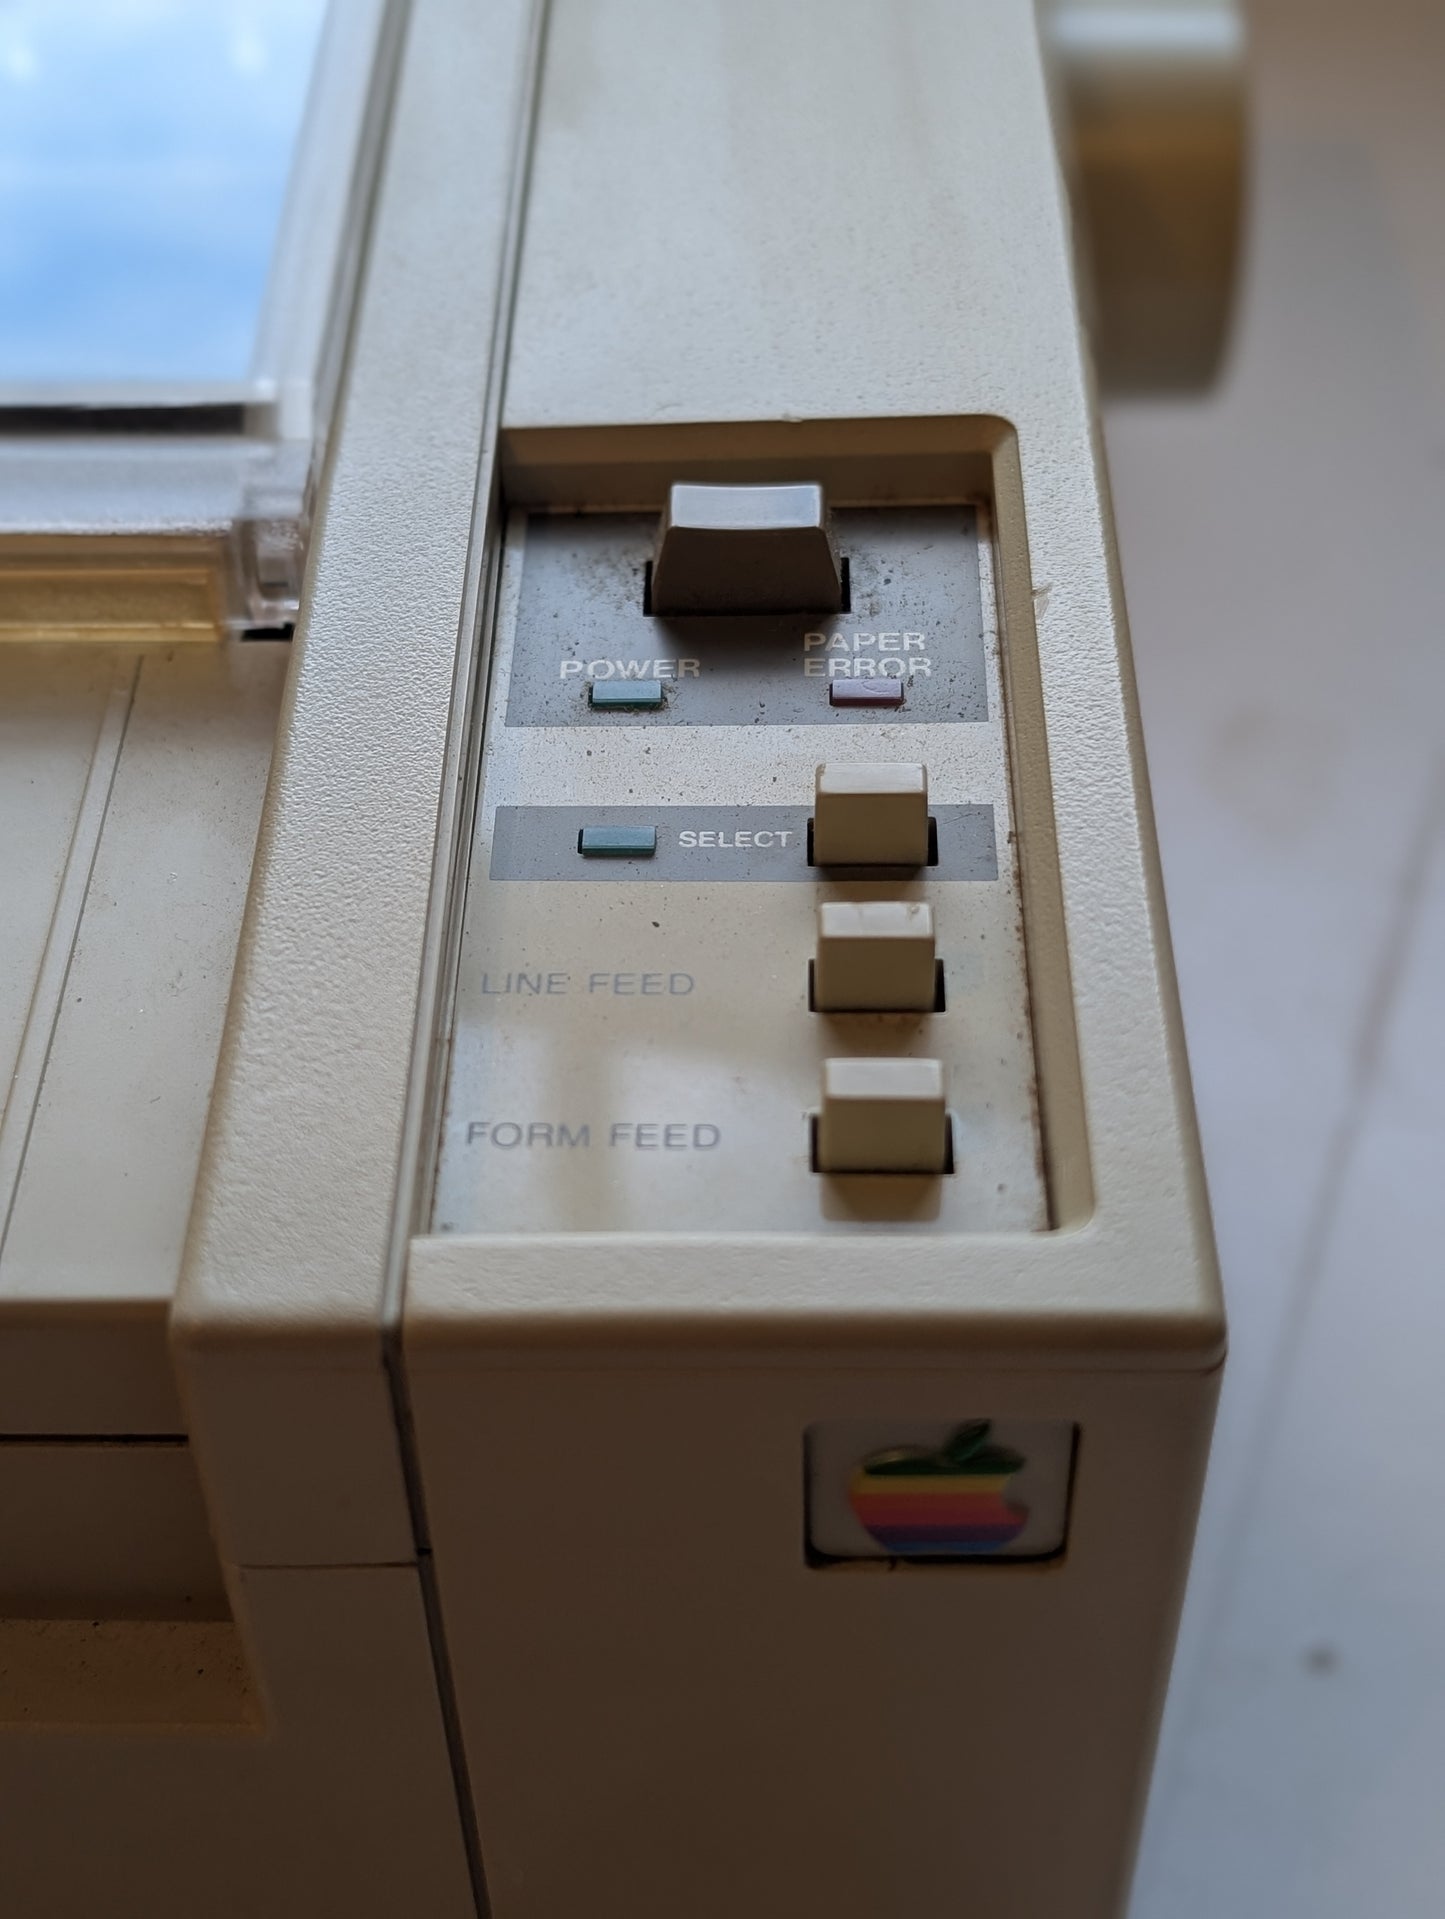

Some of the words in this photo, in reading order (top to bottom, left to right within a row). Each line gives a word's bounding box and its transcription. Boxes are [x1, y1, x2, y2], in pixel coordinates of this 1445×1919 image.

[803, 632, 926, 652] PAPER
[559, 658, 701, 680] POWER
[803, 657, 932, 678] ERROR
[678, 830, 793, 848] SELECT
[481, 972, 569, 995] LINE
[588, 972, 695, 996] FEED
[465, 1121, 591, 1149] FORM
[608, 1122, 722, 1151] FEED
